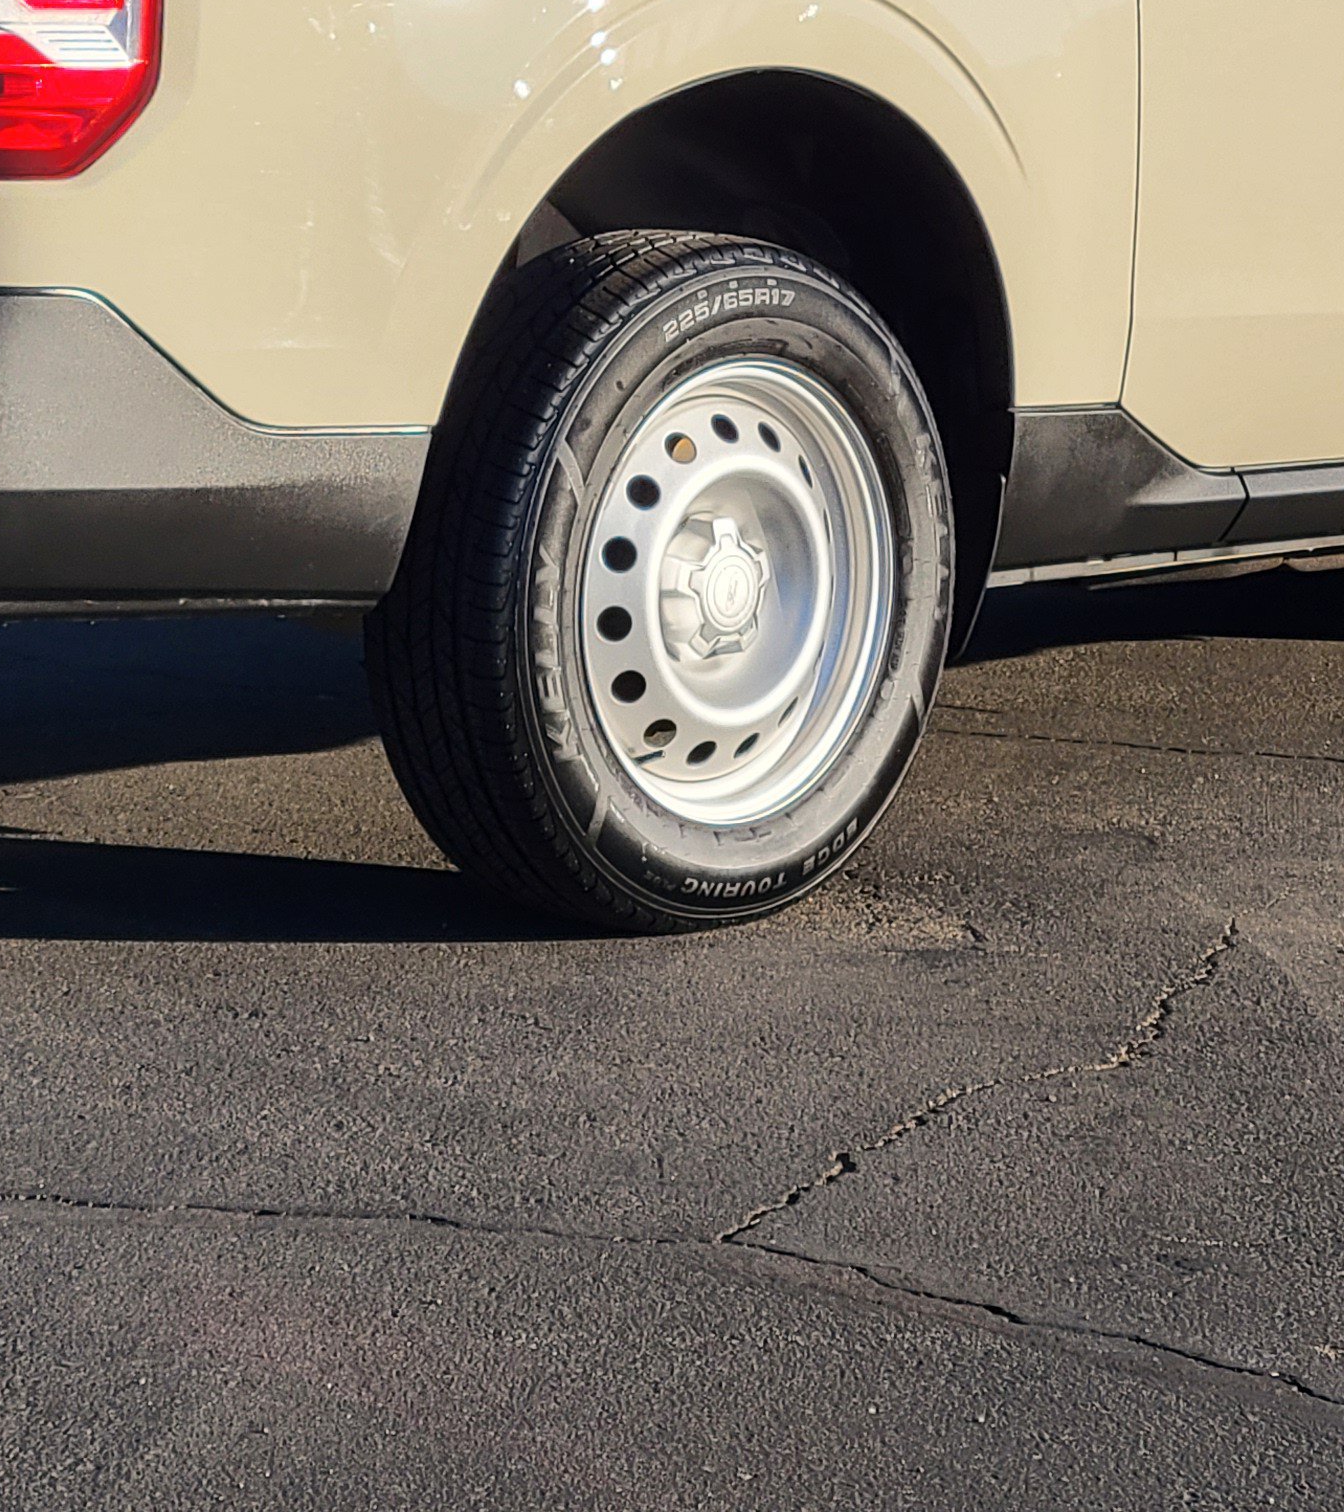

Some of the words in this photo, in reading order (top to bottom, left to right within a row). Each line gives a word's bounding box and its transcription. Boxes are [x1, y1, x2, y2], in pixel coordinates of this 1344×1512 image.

[662, 288, 796, 343] 225/65R17
[533, 543, 583, 762] KELLY
[801, 817, 859, 876] EDGE
[680, 871, 788, 899] TOURING
